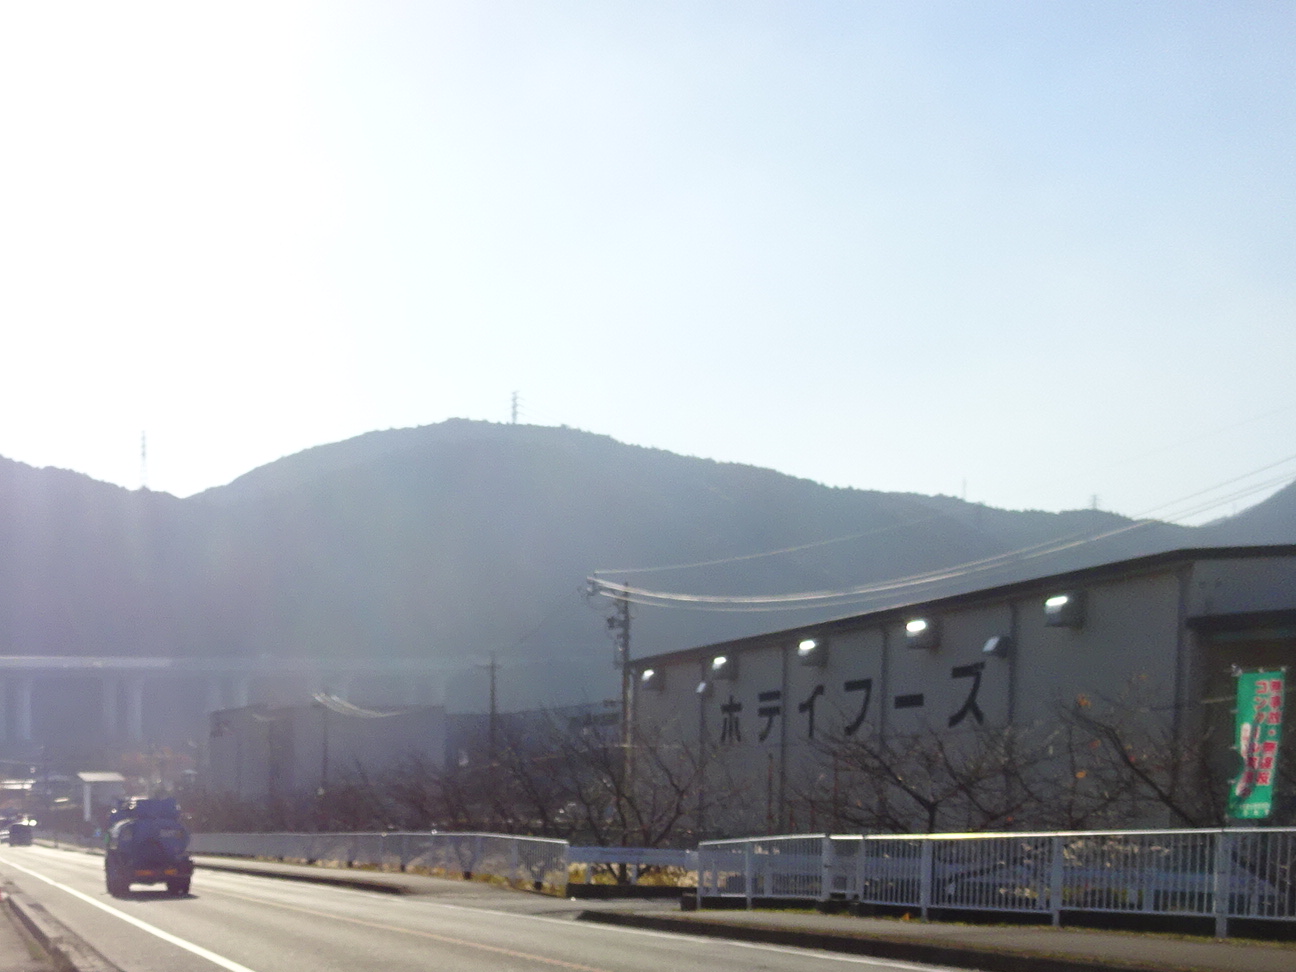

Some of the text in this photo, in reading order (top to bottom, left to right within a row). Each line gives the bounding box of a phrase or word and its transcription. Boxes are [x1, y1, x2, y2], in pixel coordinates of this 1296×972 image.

[720, 662, 986, 742] ホテイフーズ
